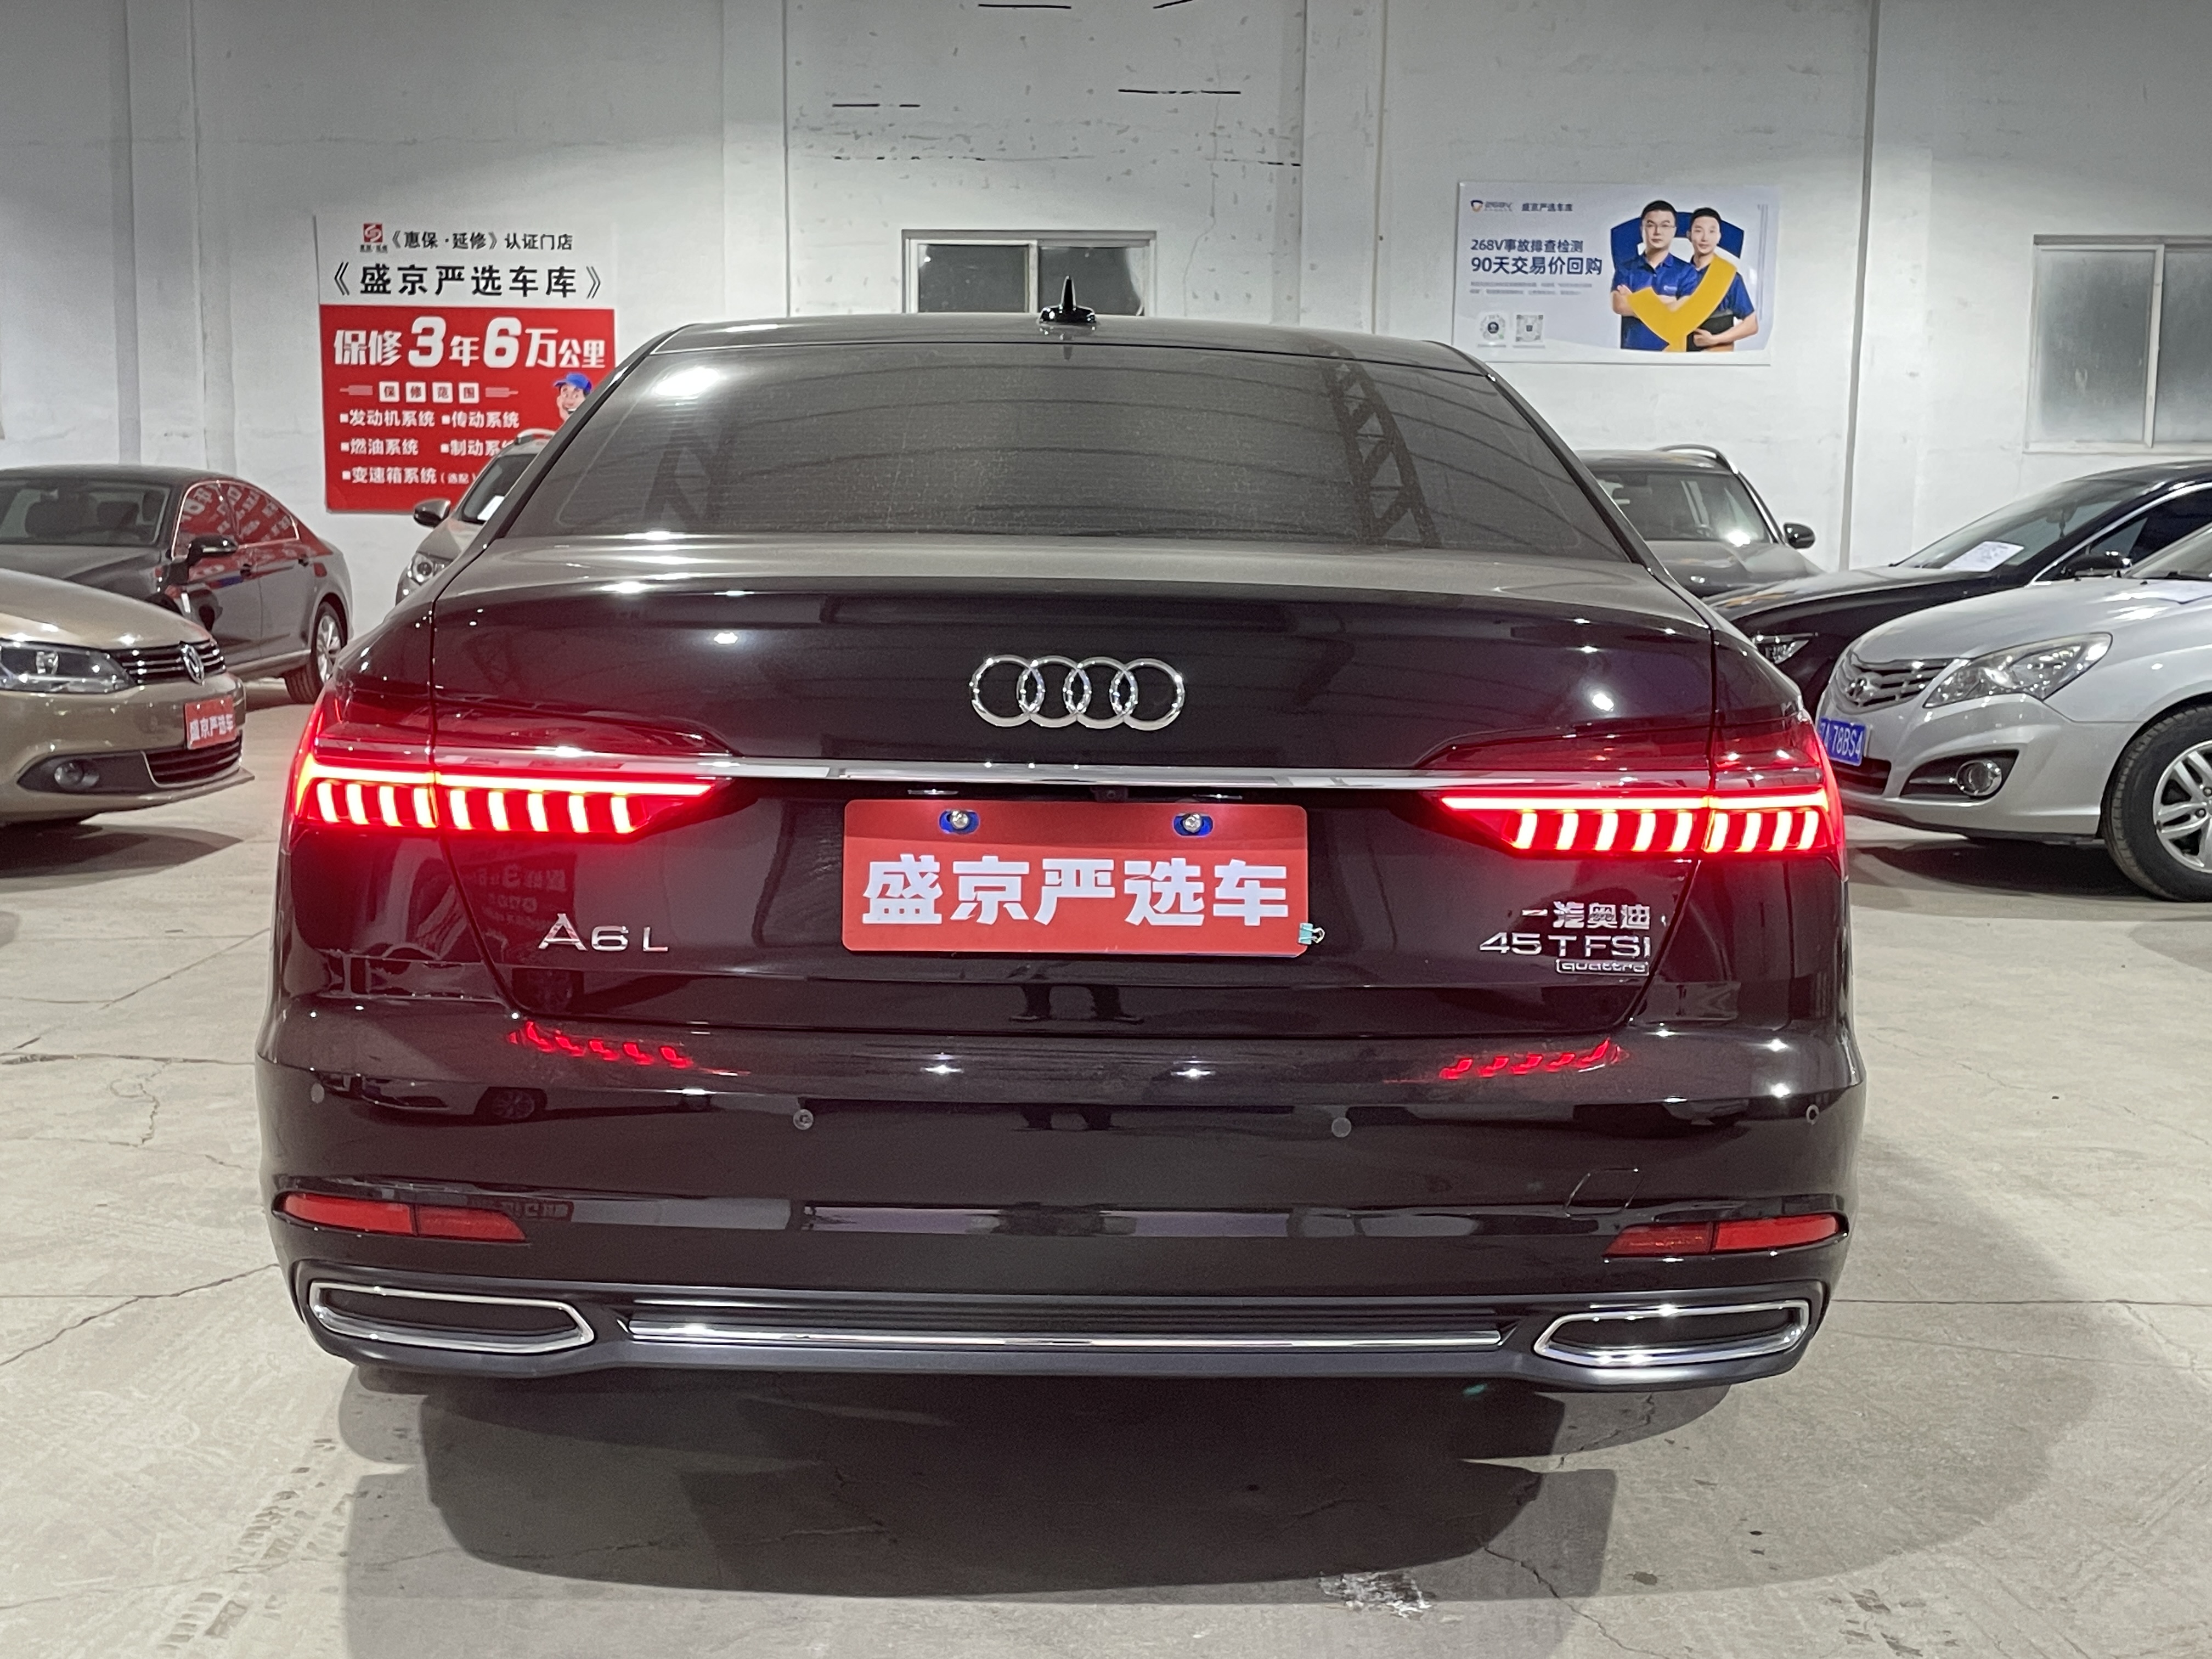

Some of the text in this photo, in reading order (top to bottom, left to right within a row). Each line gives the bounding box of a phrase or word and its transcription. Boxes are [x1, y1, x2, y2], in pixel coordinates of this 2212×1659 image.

[1471, 256, 1602, 275] 90天交易价回购
[334, 261, 601, 299] 《盛京严选车库》
[349, 409, 435, 427] 发动机系统
[452, 410, 520, 428] 传动系统
[349, 438, 419, 456] 燃油系统
[861, 853, 1289, 927] 盛京严选车
[1521, 901, 1651, 930] 一汽奥迪
[1561, 962, 1646, 974] quattro
